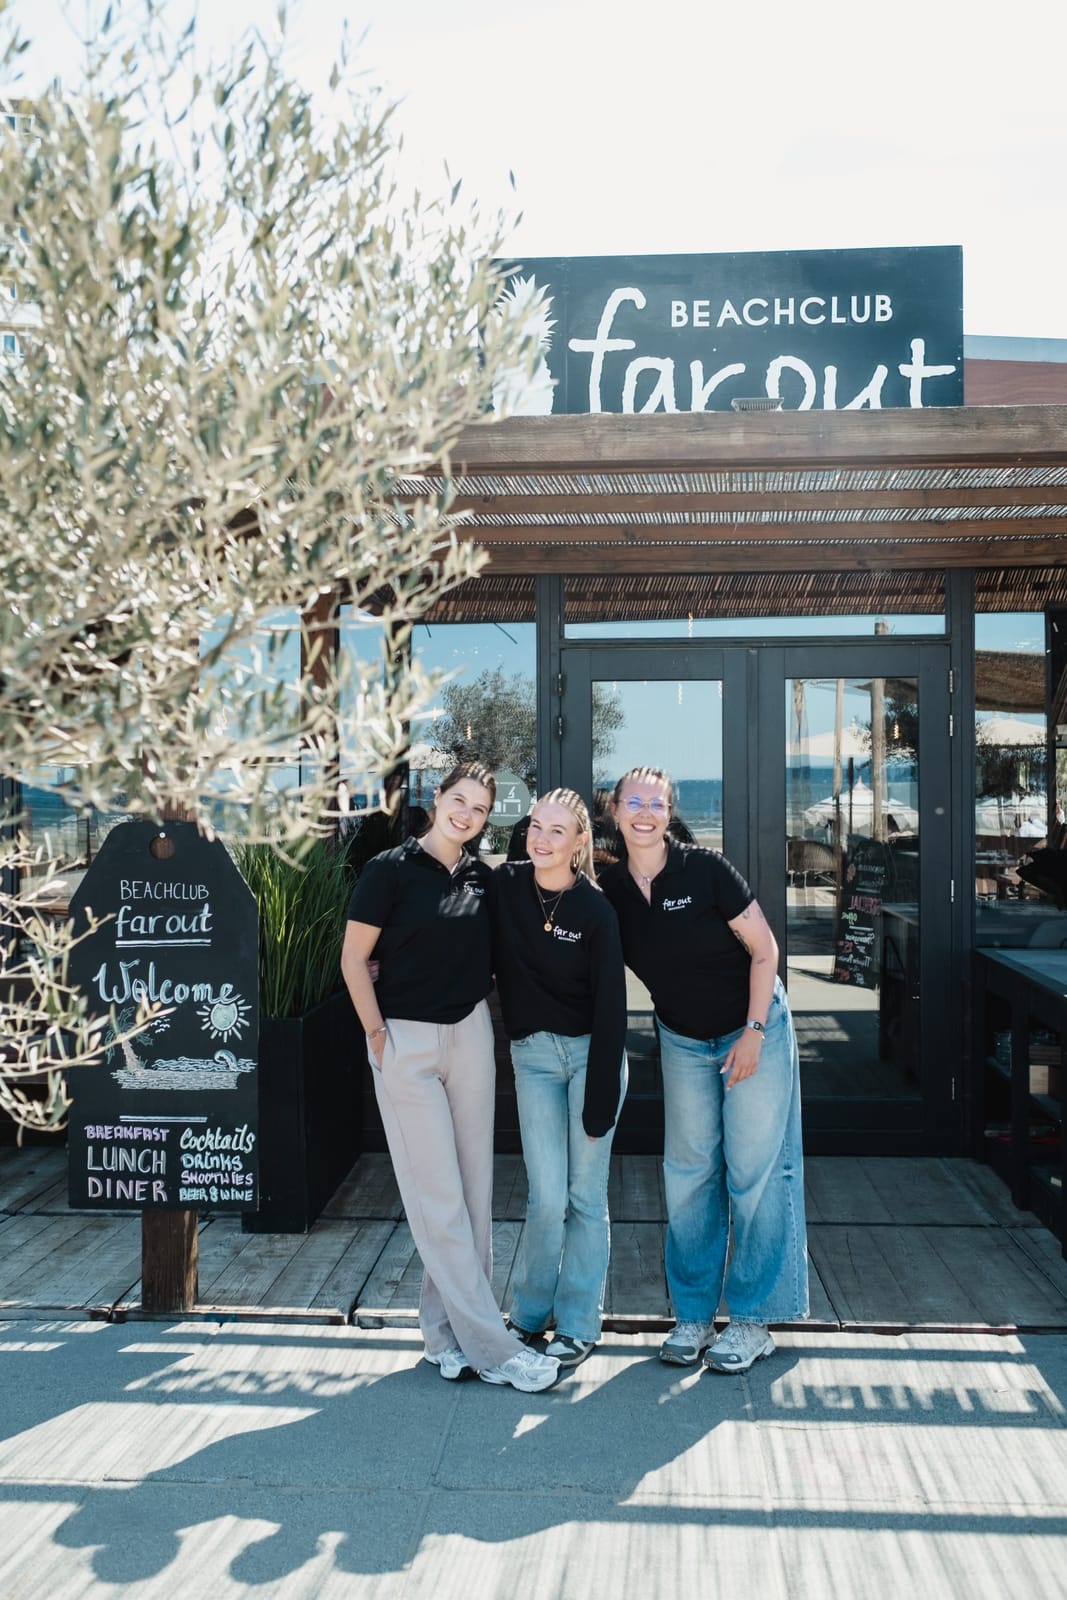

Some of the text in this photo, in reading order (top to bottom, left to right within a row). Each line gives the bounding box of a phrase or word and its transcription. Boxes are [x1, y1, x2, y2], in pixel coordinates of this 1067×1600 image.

[671, 294, 894, 328] BEACHCLUB
[568, 287, 746, 413] far
[120, 879, 210, 900] BEACHCLUB
[662, 895, 692, 911] far out
[115, 903, 213, 937] far out
[553, 925, 582, 940] far out
[92, 958, 242, 1004] Welcome
[84, 1125, 170, 1142] BREAKFAST
[180, 1124, 256, 1154] Cocktails
[87, 1146, 166, 1175] LUNCH
[88, 1177, 168, 1202] DINER
[179, 1187, 208, 1202] BEER
